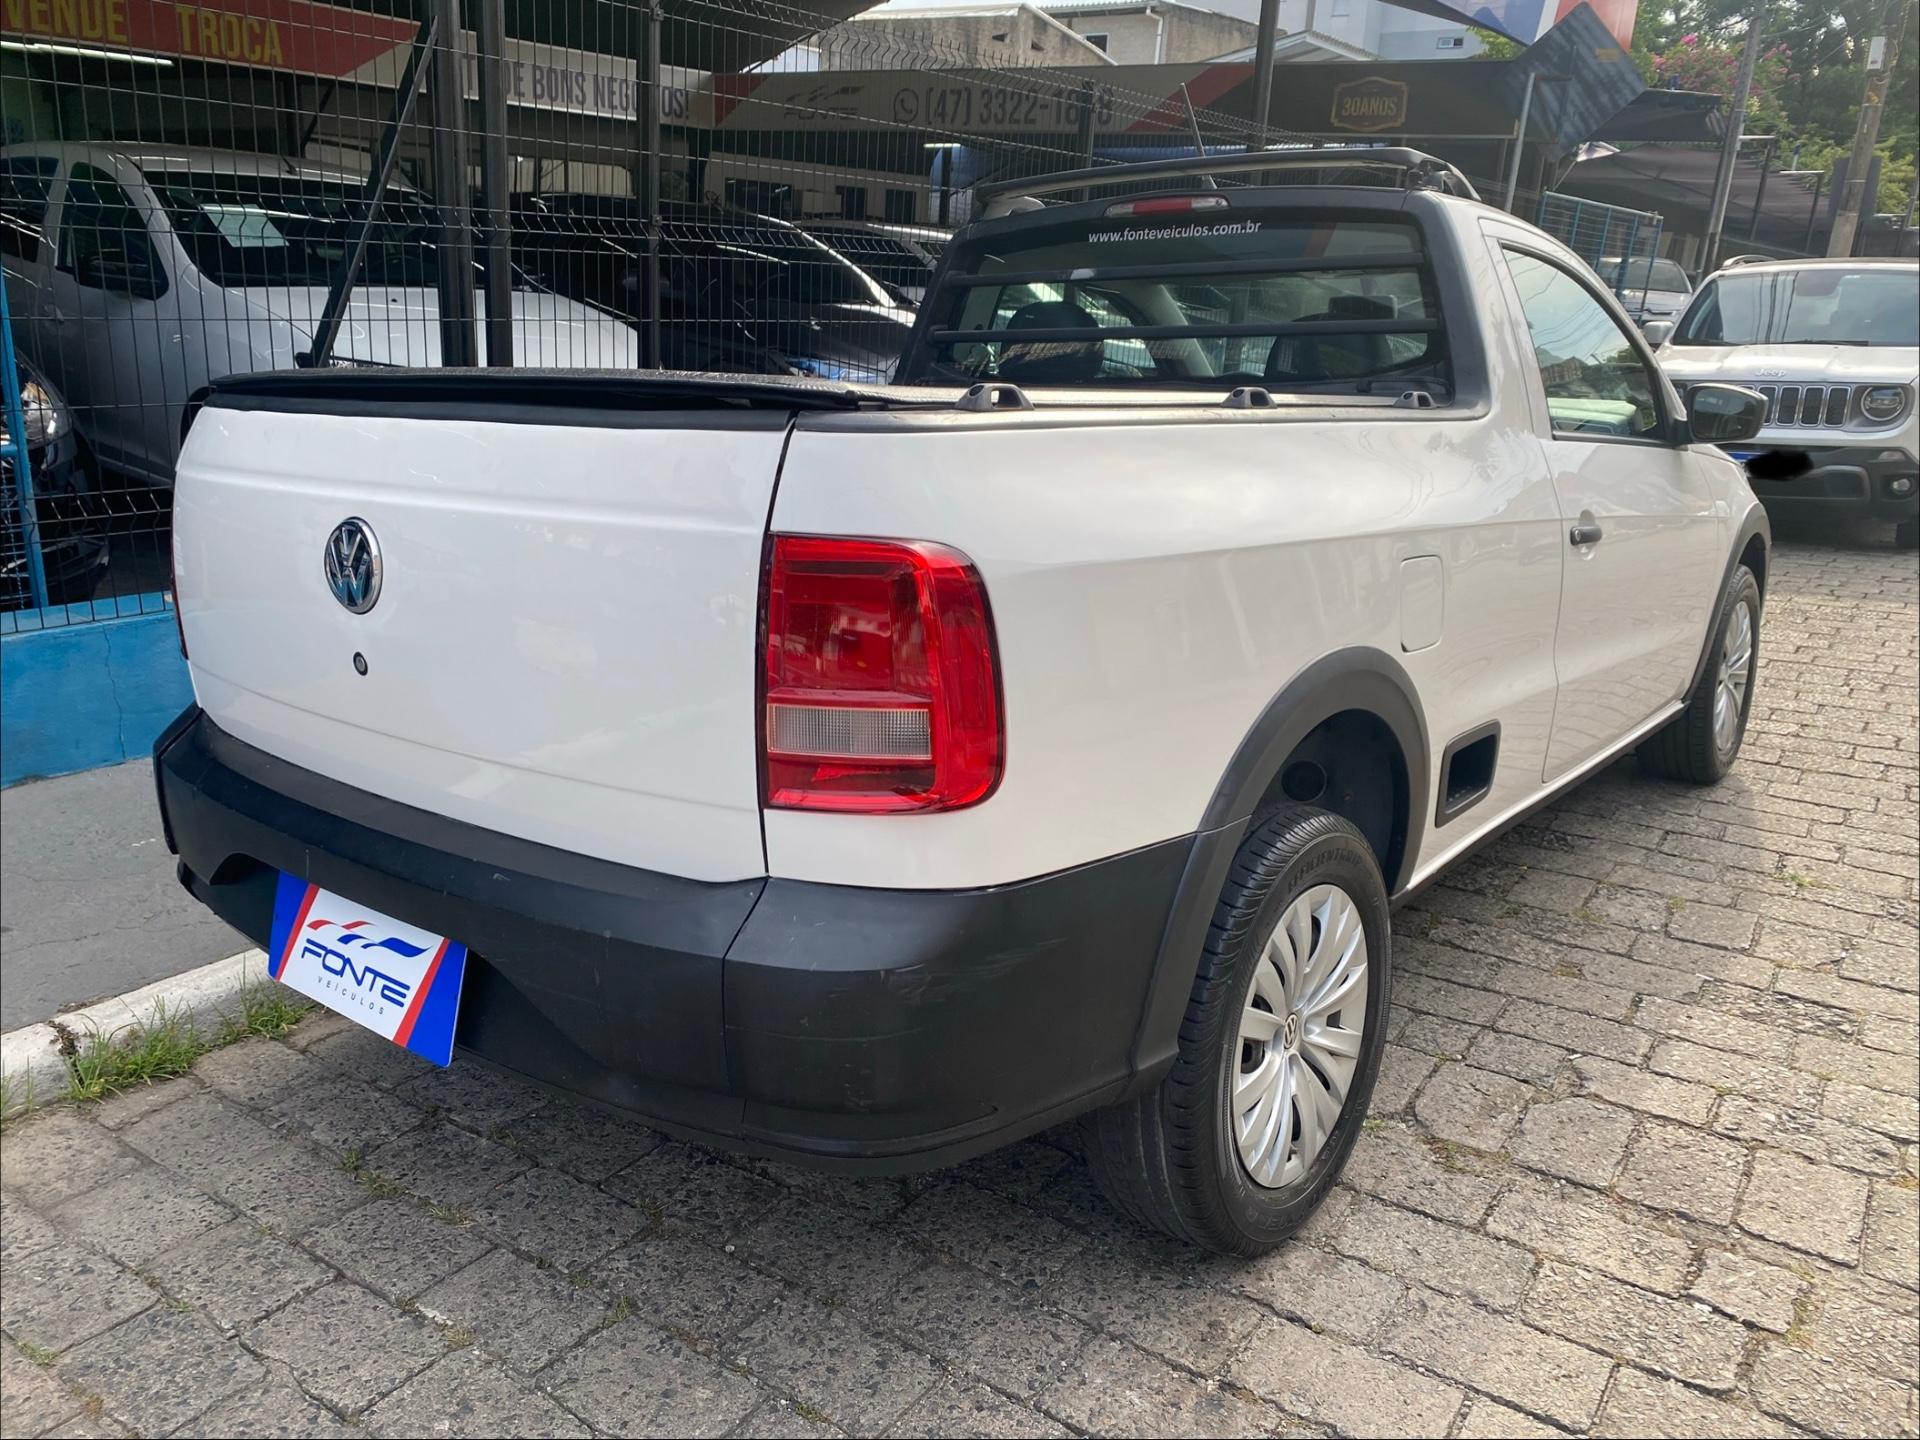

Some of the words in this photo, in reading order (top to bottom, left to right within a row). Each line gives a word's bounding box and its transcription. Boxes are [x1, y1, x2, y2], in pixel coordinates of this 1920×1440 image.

[5, 0, 128, 43] VENDE
[175, 6, 283, 65] TROCA
[531, 66, 587, 107] BONS
[926, 87, 972, 125] (47)
[1088, 220, 1261, 243] www.fonteveiculos.com.br
[1755, 368, 1787, 378] Jeep
[301, 938, 411, 1008] FONTE
